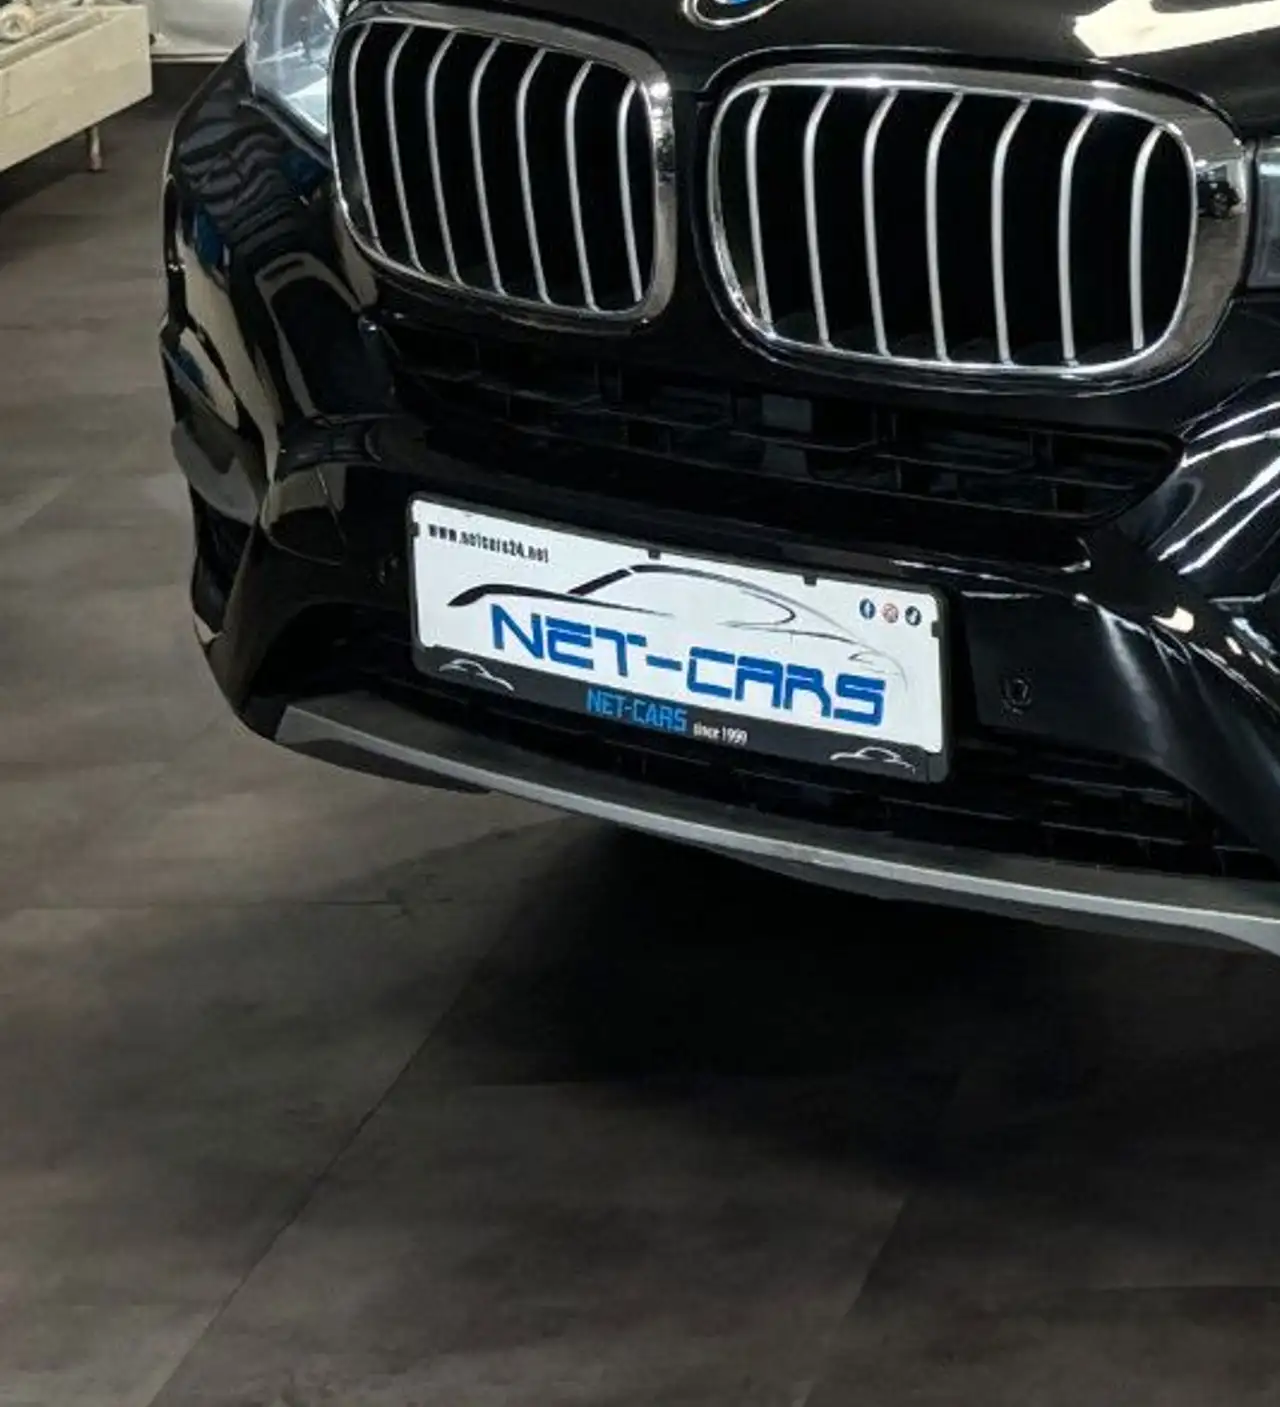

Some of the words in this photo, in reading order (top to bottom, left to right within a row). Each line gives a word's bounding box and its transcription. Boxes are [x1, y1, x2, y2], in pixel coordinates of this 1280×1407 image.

[490, 602, 886, 728] NET-CARS
[585, 688, 688, 735] NET-CARS
[692, 722, 719, 740] since
[721, 725, 749, 745] 1999
